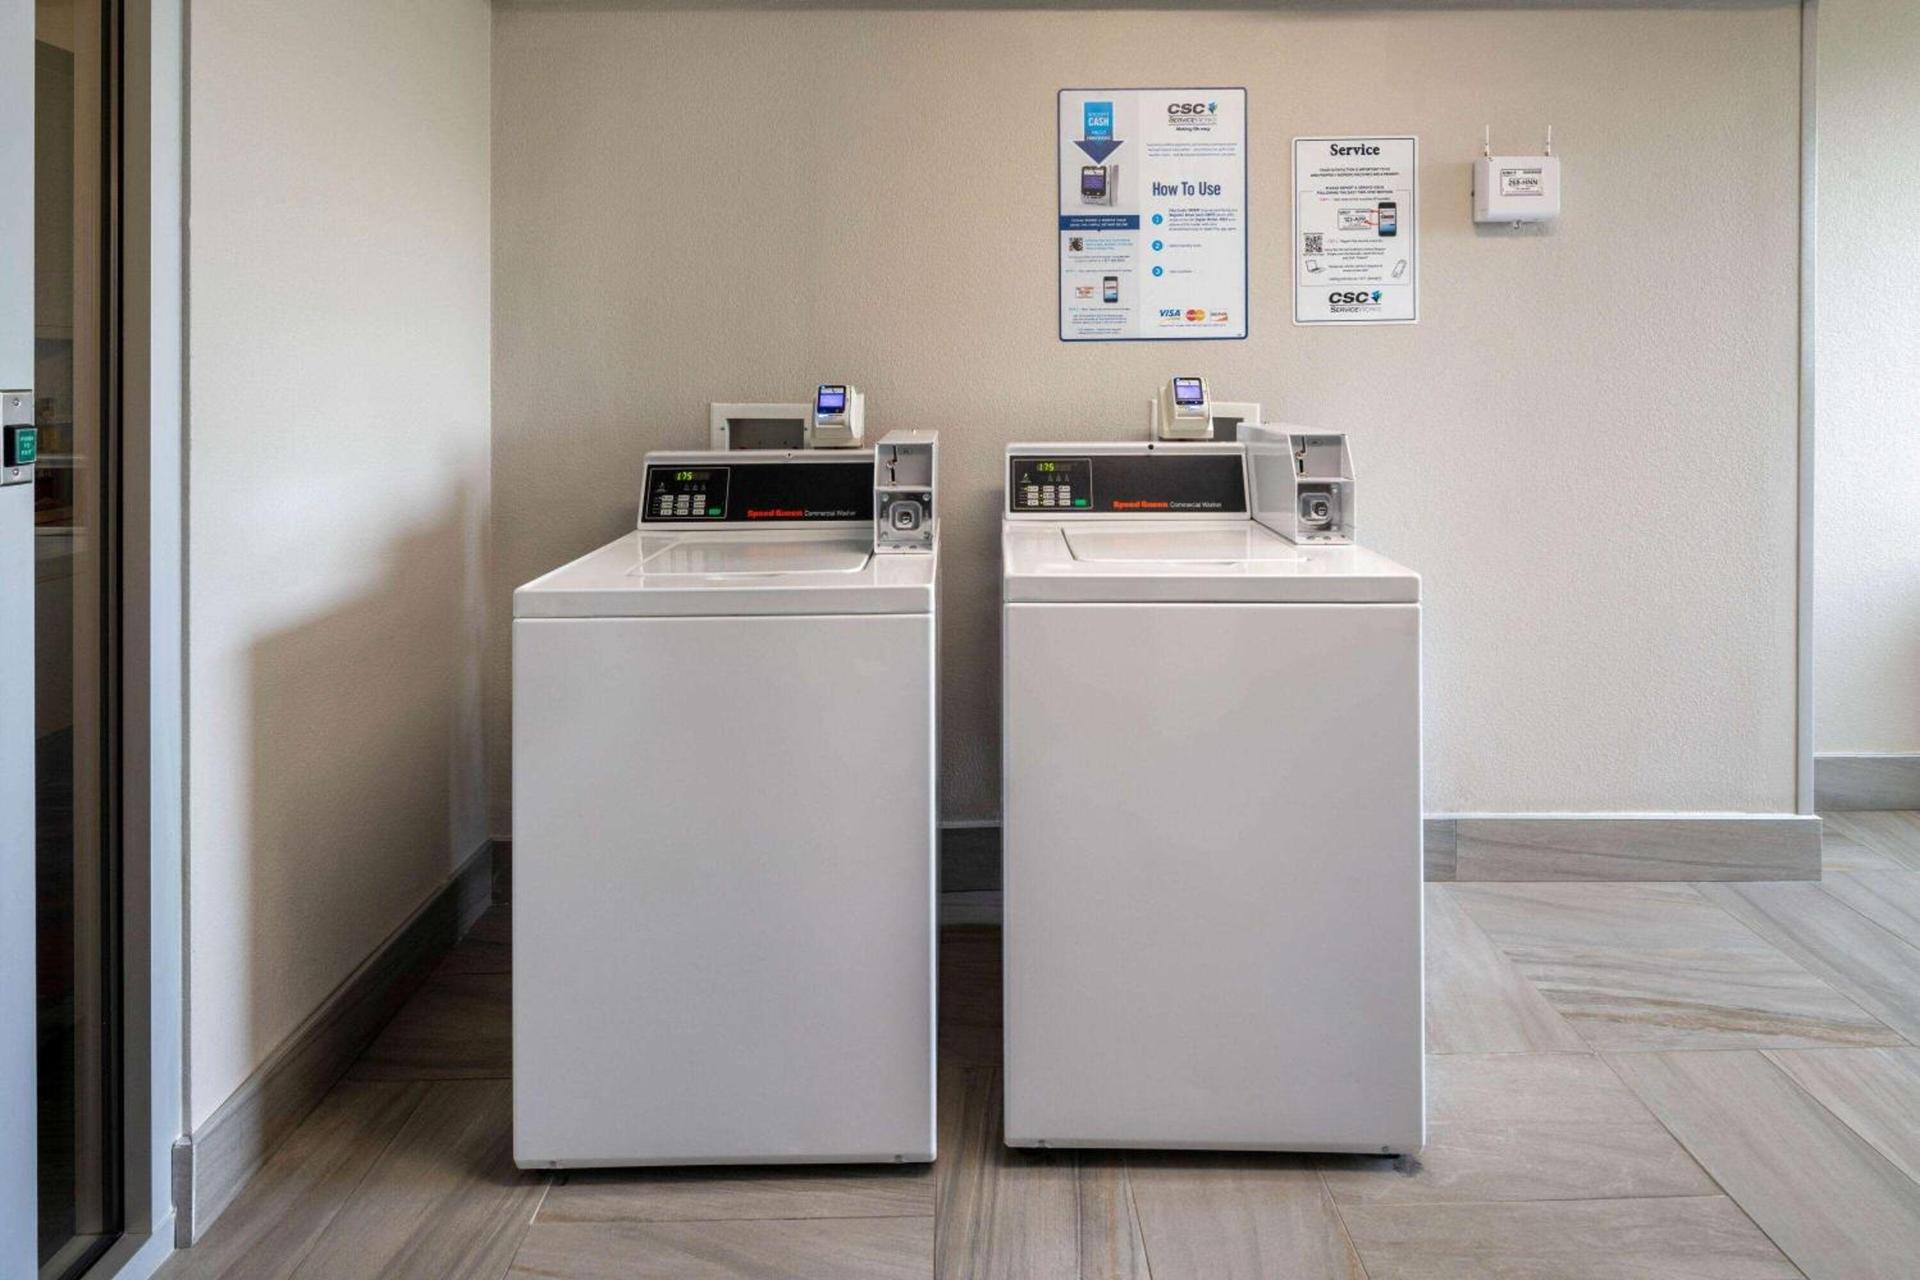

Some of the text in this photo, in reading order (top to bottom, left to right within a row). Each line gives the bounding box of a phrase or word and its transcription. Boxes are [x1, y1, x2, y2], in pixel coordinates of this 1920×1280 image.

[1167, 103, 1205, 115] CSC
[1088, 116, 1110, 127] CASH
[1330, 143, 1381, 156] Service
[1152, 181, 1221, 196] How To Use
[1328, 291, 1370, 304] CSC
[1159, 309, 1181, 317] VISA
